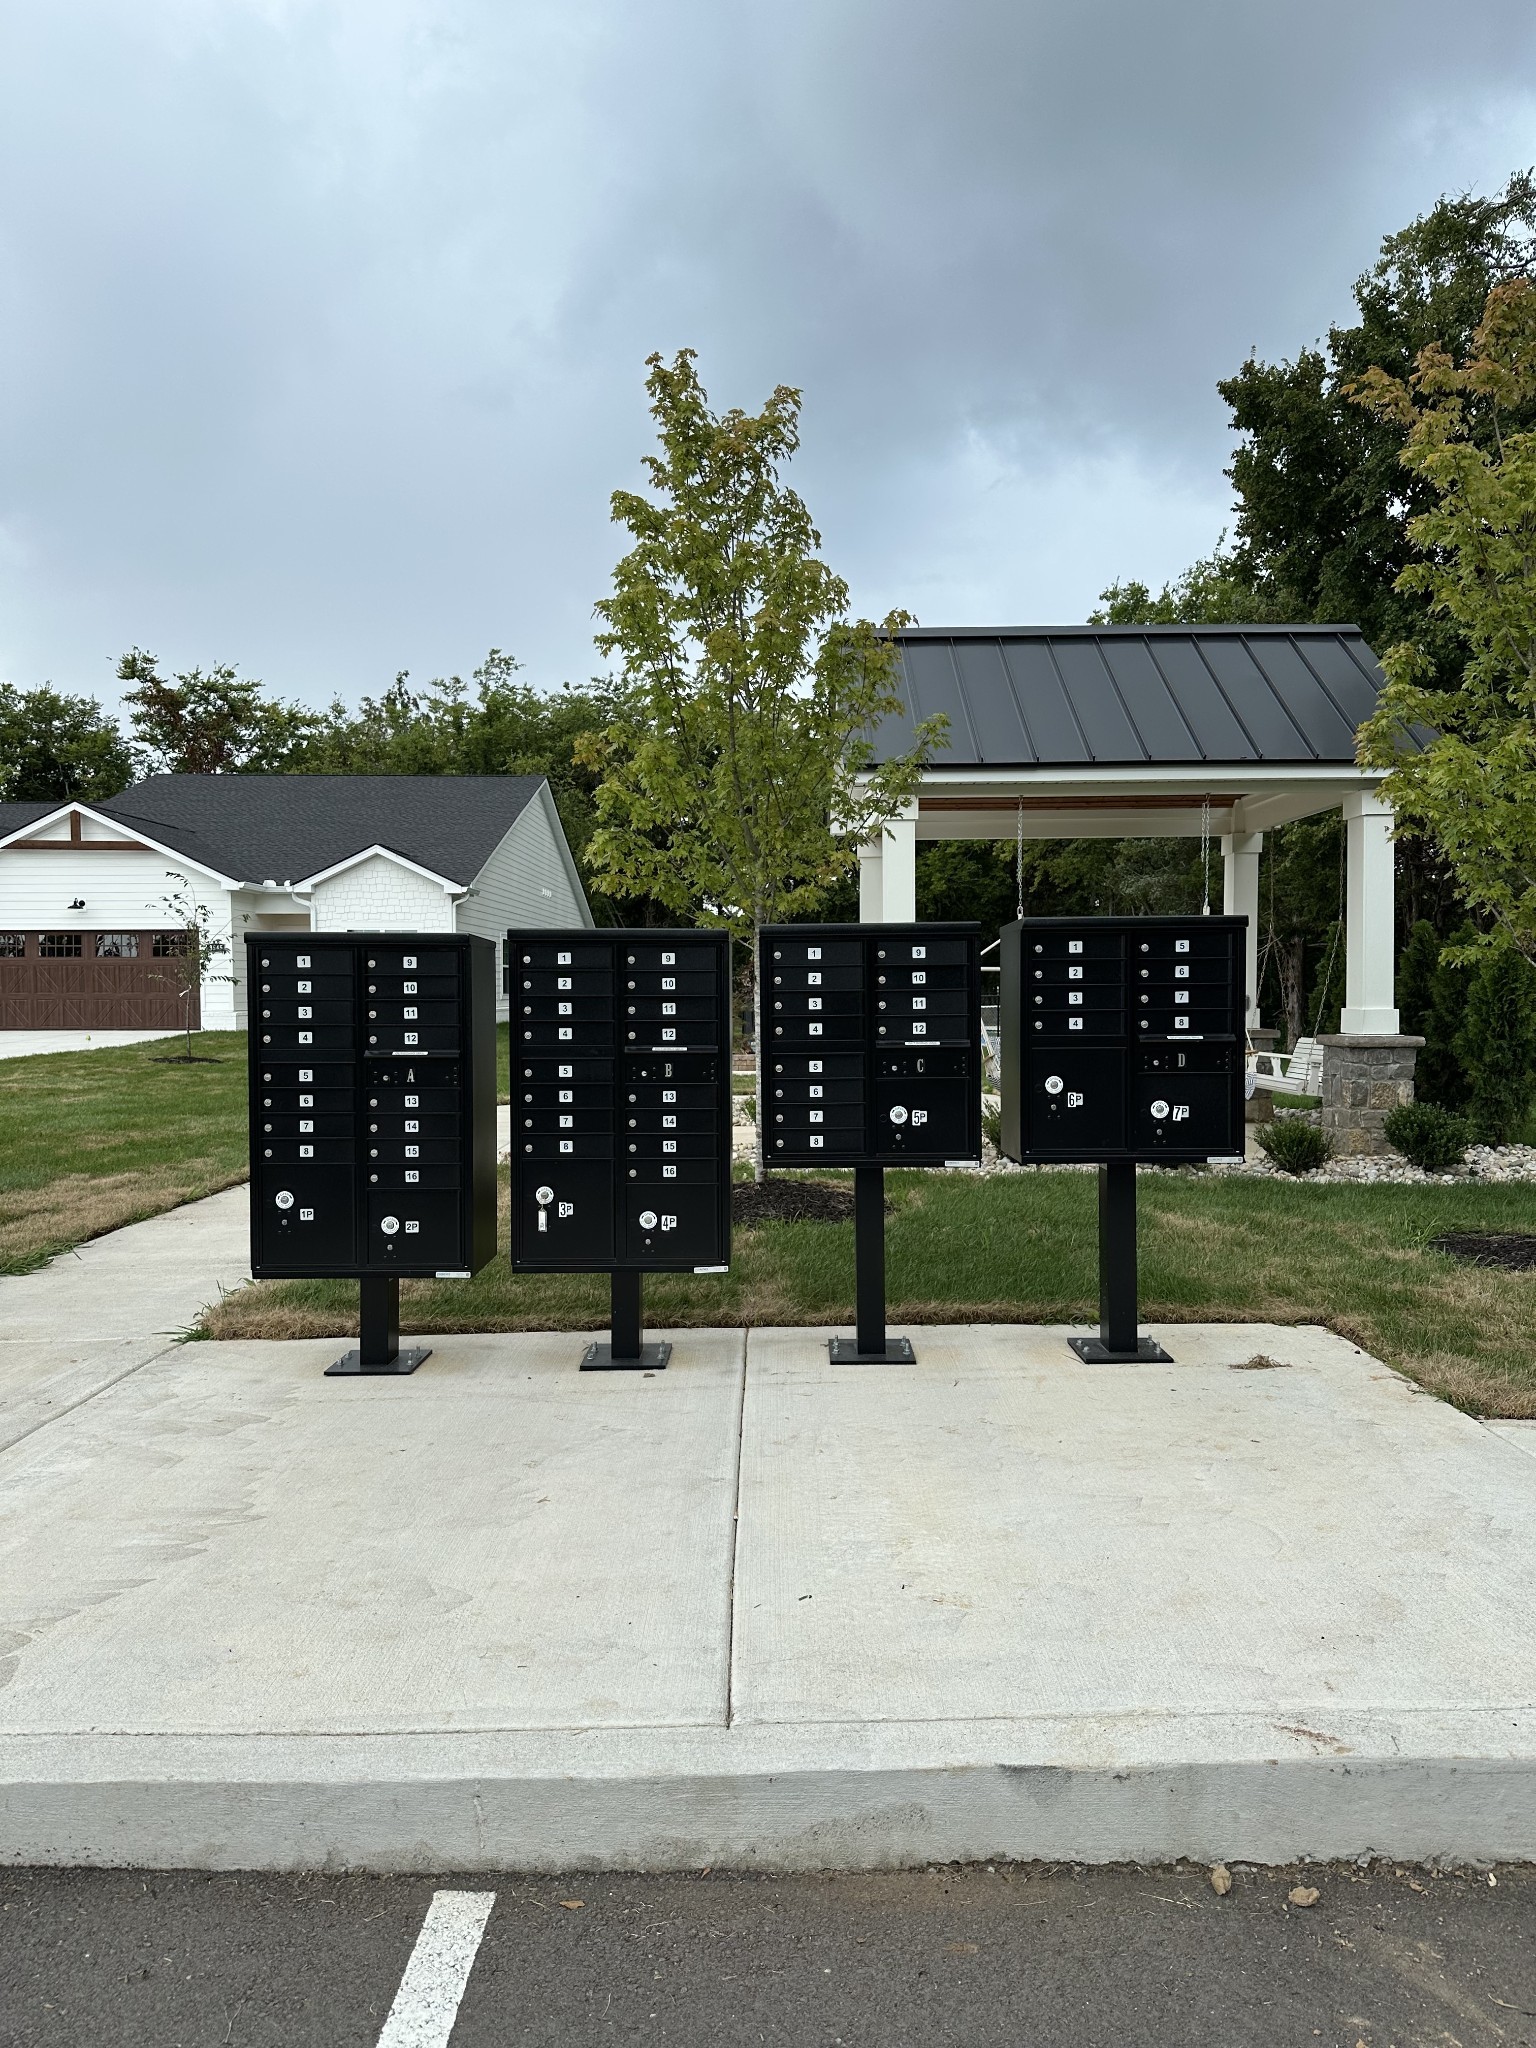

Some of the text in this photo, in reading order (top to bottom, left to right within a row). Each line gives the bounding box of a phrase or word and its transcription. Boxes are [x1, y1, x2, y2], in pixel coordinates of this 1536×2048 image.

[1179, 942, 1186, 950] 5
[915, 948, 922, 957] 9
[406, 958, 413, 967] 9
[665, 954, 671, 963] 9
[1072, 968, 1078, 977] 2
[1179, 967, 1185, 976] 6
[812, 975, 817, 983] 2
[913, 974, 924, 982] 10
[301, 983, 308, 991] 2
[405, 983, 416, 992] 10
[562, 979, 568, 988] 2
[663, 979, 674, 988] 10
[1072, 994, 1079, 1002] 3
[1178, 993, 1185, 1001] 7
[812, 1000, 818, 1008] 3
[914, 999, 924, 1008] 11
[302, 1008, 308, 1017] 3
[405, 1009, 415, 1017] 11
[562, 1004, 568, 1013] 3
[663, 1004, 674, 1013] 11
[1072, 1019, 1079, 1027] 4
[1178, 1018, 1185, 1027] 8
[812, 1025, 819, 1033] 4
[914, 1024, 925, 1033] 12
[302, 1033, 308, 1042] 4
[406, 1034, 417, 1042] 12
[663, 1030, 674, 1038] 12
[1177, 1053, 1186, 1068] D
[812, 1063, 819, 1071] 5
[916, 1058, 925, 1073] C
[563, 1067, 569, 1075] 5
[664, 1063, 673, 1078] B
[303, 1071, 309, 1080] 5
[406, 1068, 415, 1083] A
[563, 1092, 569, 1100] 6
[813, 1087, 819, 1096] 6
[303, 1096, 310, 1105] 6
[406, 1097, 417, 1105] 13
[664, 1092, 675, 1101] 13
[1068, 1093, 1082, 1106] 6P
[813, 1112, 819, 1121] 7
[1174, 1106, 1188, 1120] 7P
[563, 1117, 569, 1125] 7
[664, 1117, 675, 1126] 14
[913, 1111, 926, 1125] 5P
[303, 1122, 309, 1130] 7
[406, 1122, 417, 1130] 14
[664, 1142, 675, 1150] 15
[303, 1147, 309, 1156] 8
[406, 1147, 418, 1156] 15
[664, 1167, 675, 1175] 16
[406, 1172, 418, 1180] 16
[301, 1210, 313, 1218] 1P
[559, 1203, 572, 1216] 3P
[406, 1223, 418, 1231] 2P
[662, 1216, 676, 1230] 4P
